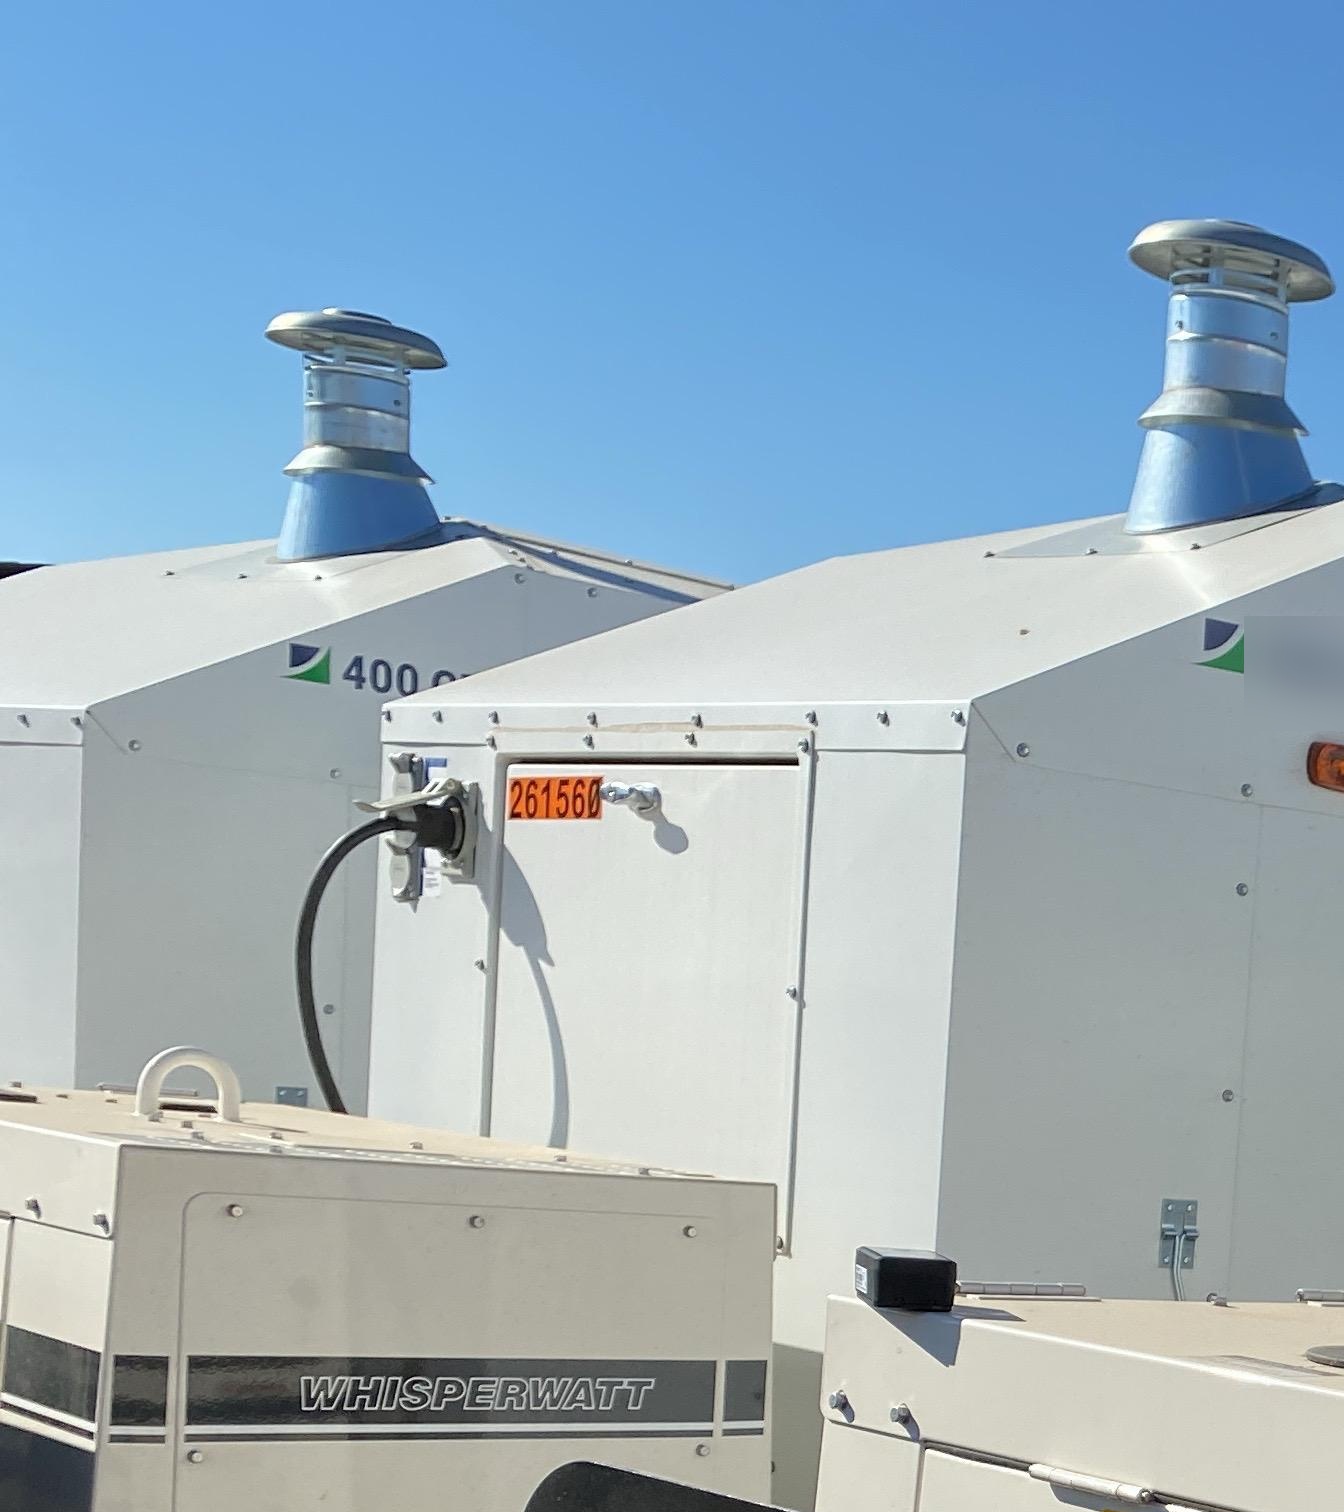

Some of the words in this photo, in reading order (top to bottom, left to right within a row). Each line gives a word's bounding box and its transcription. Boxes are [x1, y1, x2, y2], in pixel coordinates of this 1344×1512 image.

[342, 655, 419, 697] 400
[509, 779, 601, 819] 261560
[299, 1375, 657, 1411] WHISPERWATT
